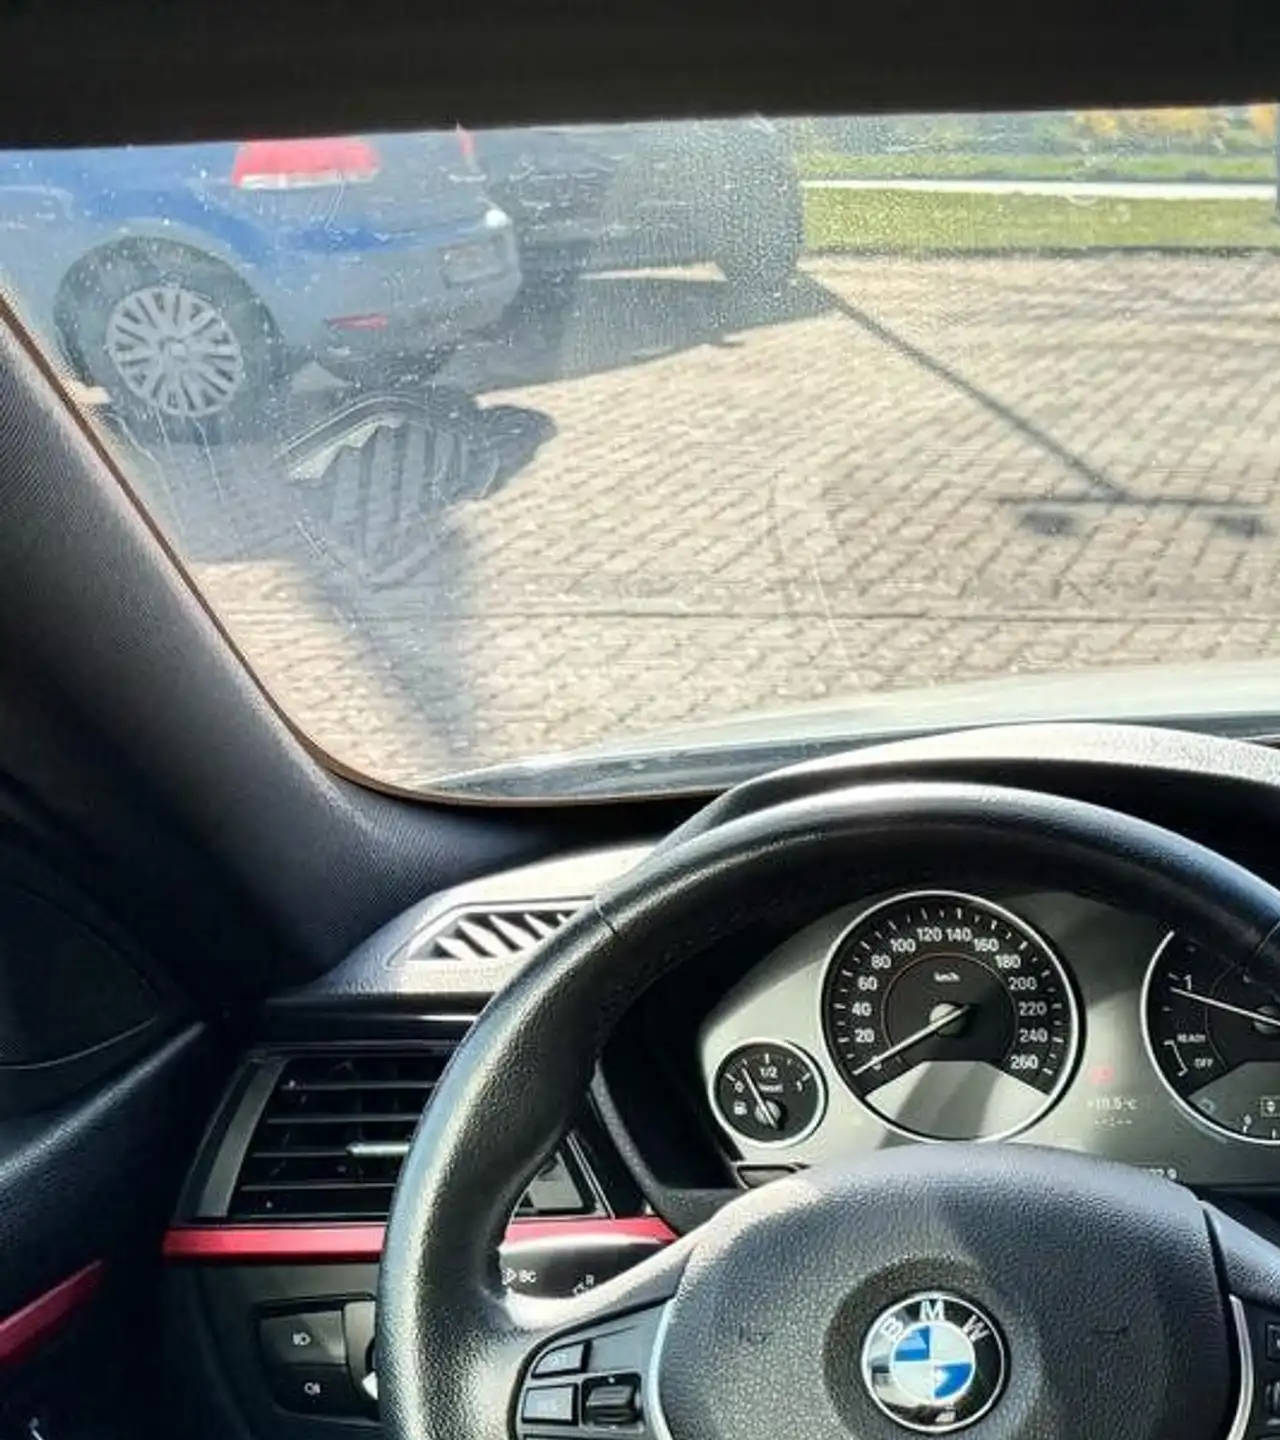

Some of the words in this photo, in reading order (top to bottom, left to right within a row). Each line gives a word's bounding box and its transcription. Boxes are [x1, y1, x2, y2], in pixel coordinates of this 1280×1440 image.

[915, 928, 943, 942] 120
[945, 928, 972, 942] 140
[890, 938, 916, 952] 100
[973, 938, 999, 952] 160
[871, 954, 891, 969] 80
[995, 954, 1021, 968] 180
[857, 976, 878, 991] 60
[1008, 976, 1037, 990] 200
[851, 1002, 872, 1016] 40
[1018, 1002, 1047, 1016] 220
[854, 1028, 875, 1043] 20
[1019, 1028, 1048, 1043] 240
[1010, 1054, 1039, 1069] 260
[879, 1299, 991, 1343] BMW
